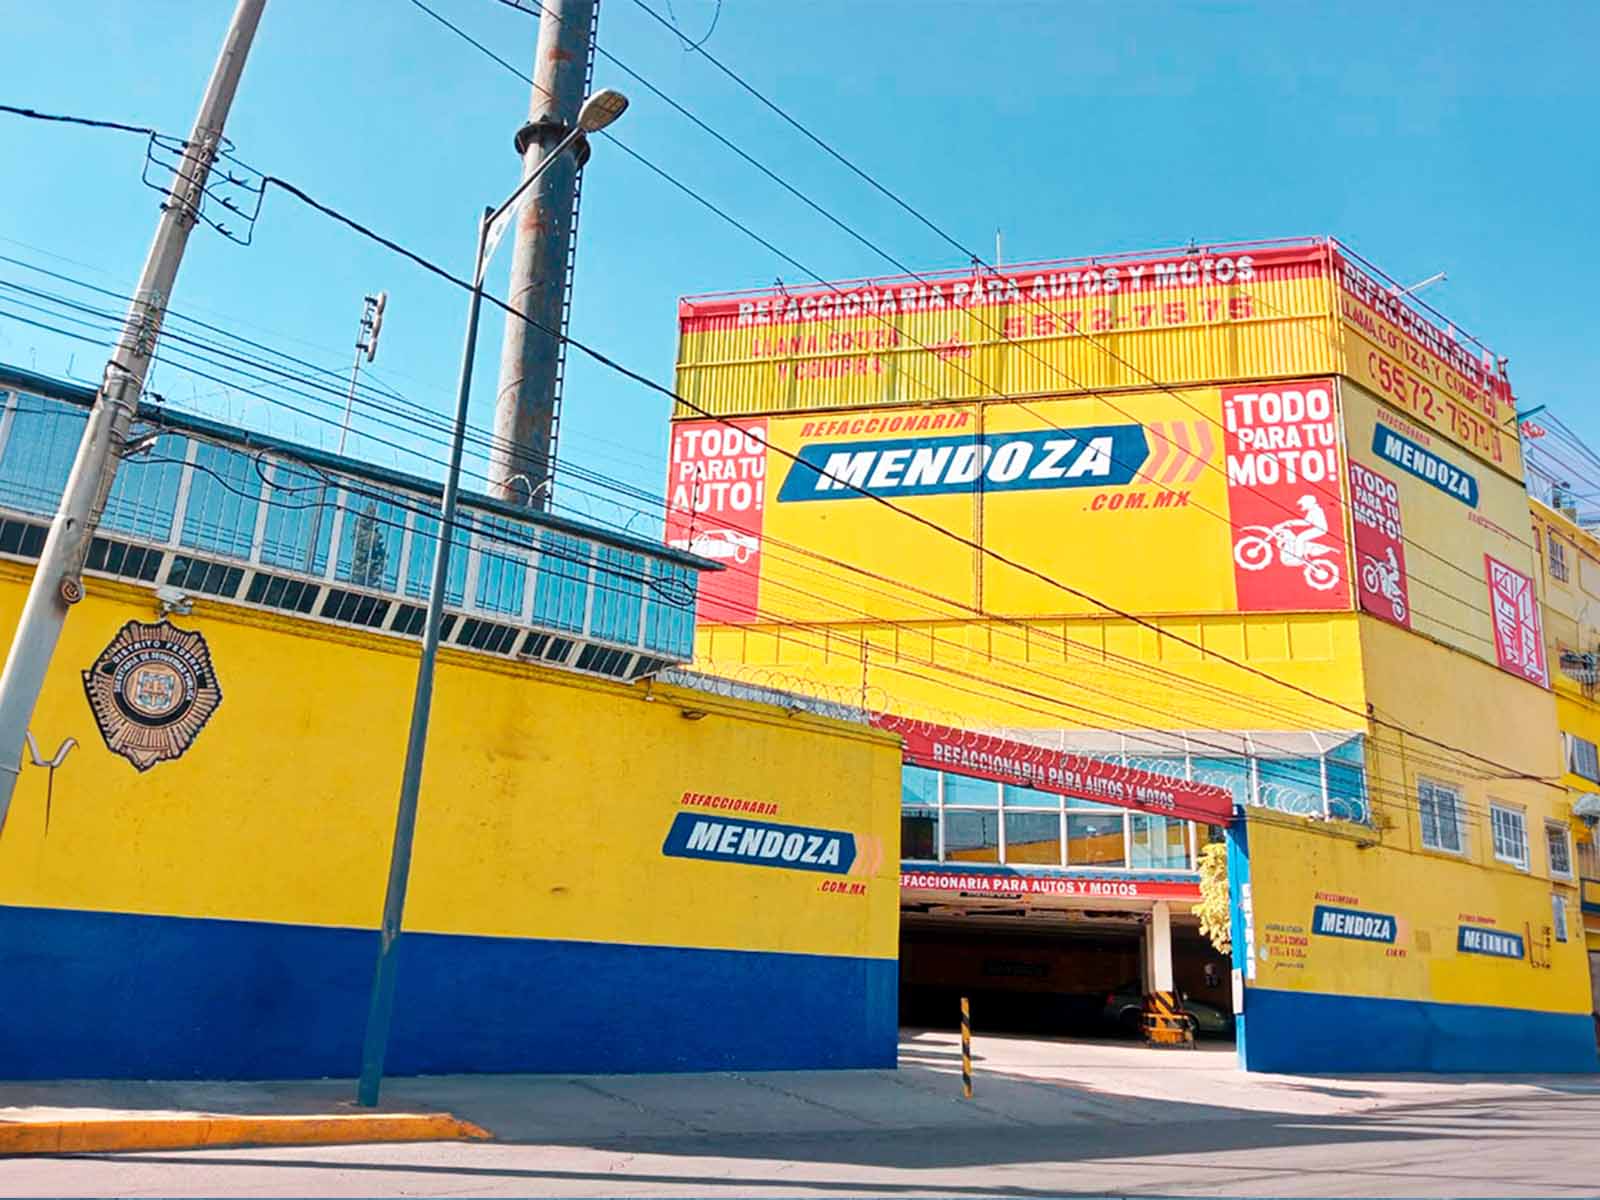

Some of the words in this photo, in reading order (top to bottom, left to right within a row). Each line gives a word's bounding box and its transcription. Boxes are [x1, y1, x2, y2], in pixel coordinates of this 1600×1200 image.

[738, 286, 945, 326] REFACCIONARIA
[954, 279, 1020, 304] PARA
[1032, 268, 1119, 300] AUTOS
[1127, 264, 1145, 288] Y
[1155, 256, 1254, 287] MOTOS
[1004, 296, 1254, 339] 5572-7575
[800, 412, 969, 437] REFACCIONARIA
[1225, 388, 1331, 433] ¡TODO
[674, 427, 767, 464] ¡TODO
[1238, 426, 1298, 452] PARA
[1301, 423, 1336, 446] TU
[679, 458, 738, 482] PARA
[741, 456, 765, 478] TU
[814, 435, 1114, 492] MENDOZA
[1227, 450, 1338, 488] MOTO!
[1384, 434, 1471, 500] MENDOZA
[672, 480, 763, 514] AUTO!
[1083, 491, 1191, 512] .COM.MX
[1356, 486, 1384, 514] PARA
[112, 640, 160, 664] DISTRITO
[166, 641, 203, 676] FEDERAL
[933, 743, 1044, 781] REFACCIONARIA
[1048, 767, 1082, 791] PARA
[1086, 775, 1124, 800] AUTOS
[1126, 785, 1134, 800] Y
[1136, 787, 1176, 811] MOTOS
[681, 792, 778, 816] REFACCIONARIA
[686, 821, 841, 866] MENDOZA
[899, 873, 989, 890] EFACCIONARIA
[993, 879, 1028, 892] PARA
[1032, 880, 1074, 894] AUTOS
[1078, 881, 1087, 894] Y
[1090, 881, 1138, 896] MOTOS
[1321, 911, 1391, 939] MENDOZA
